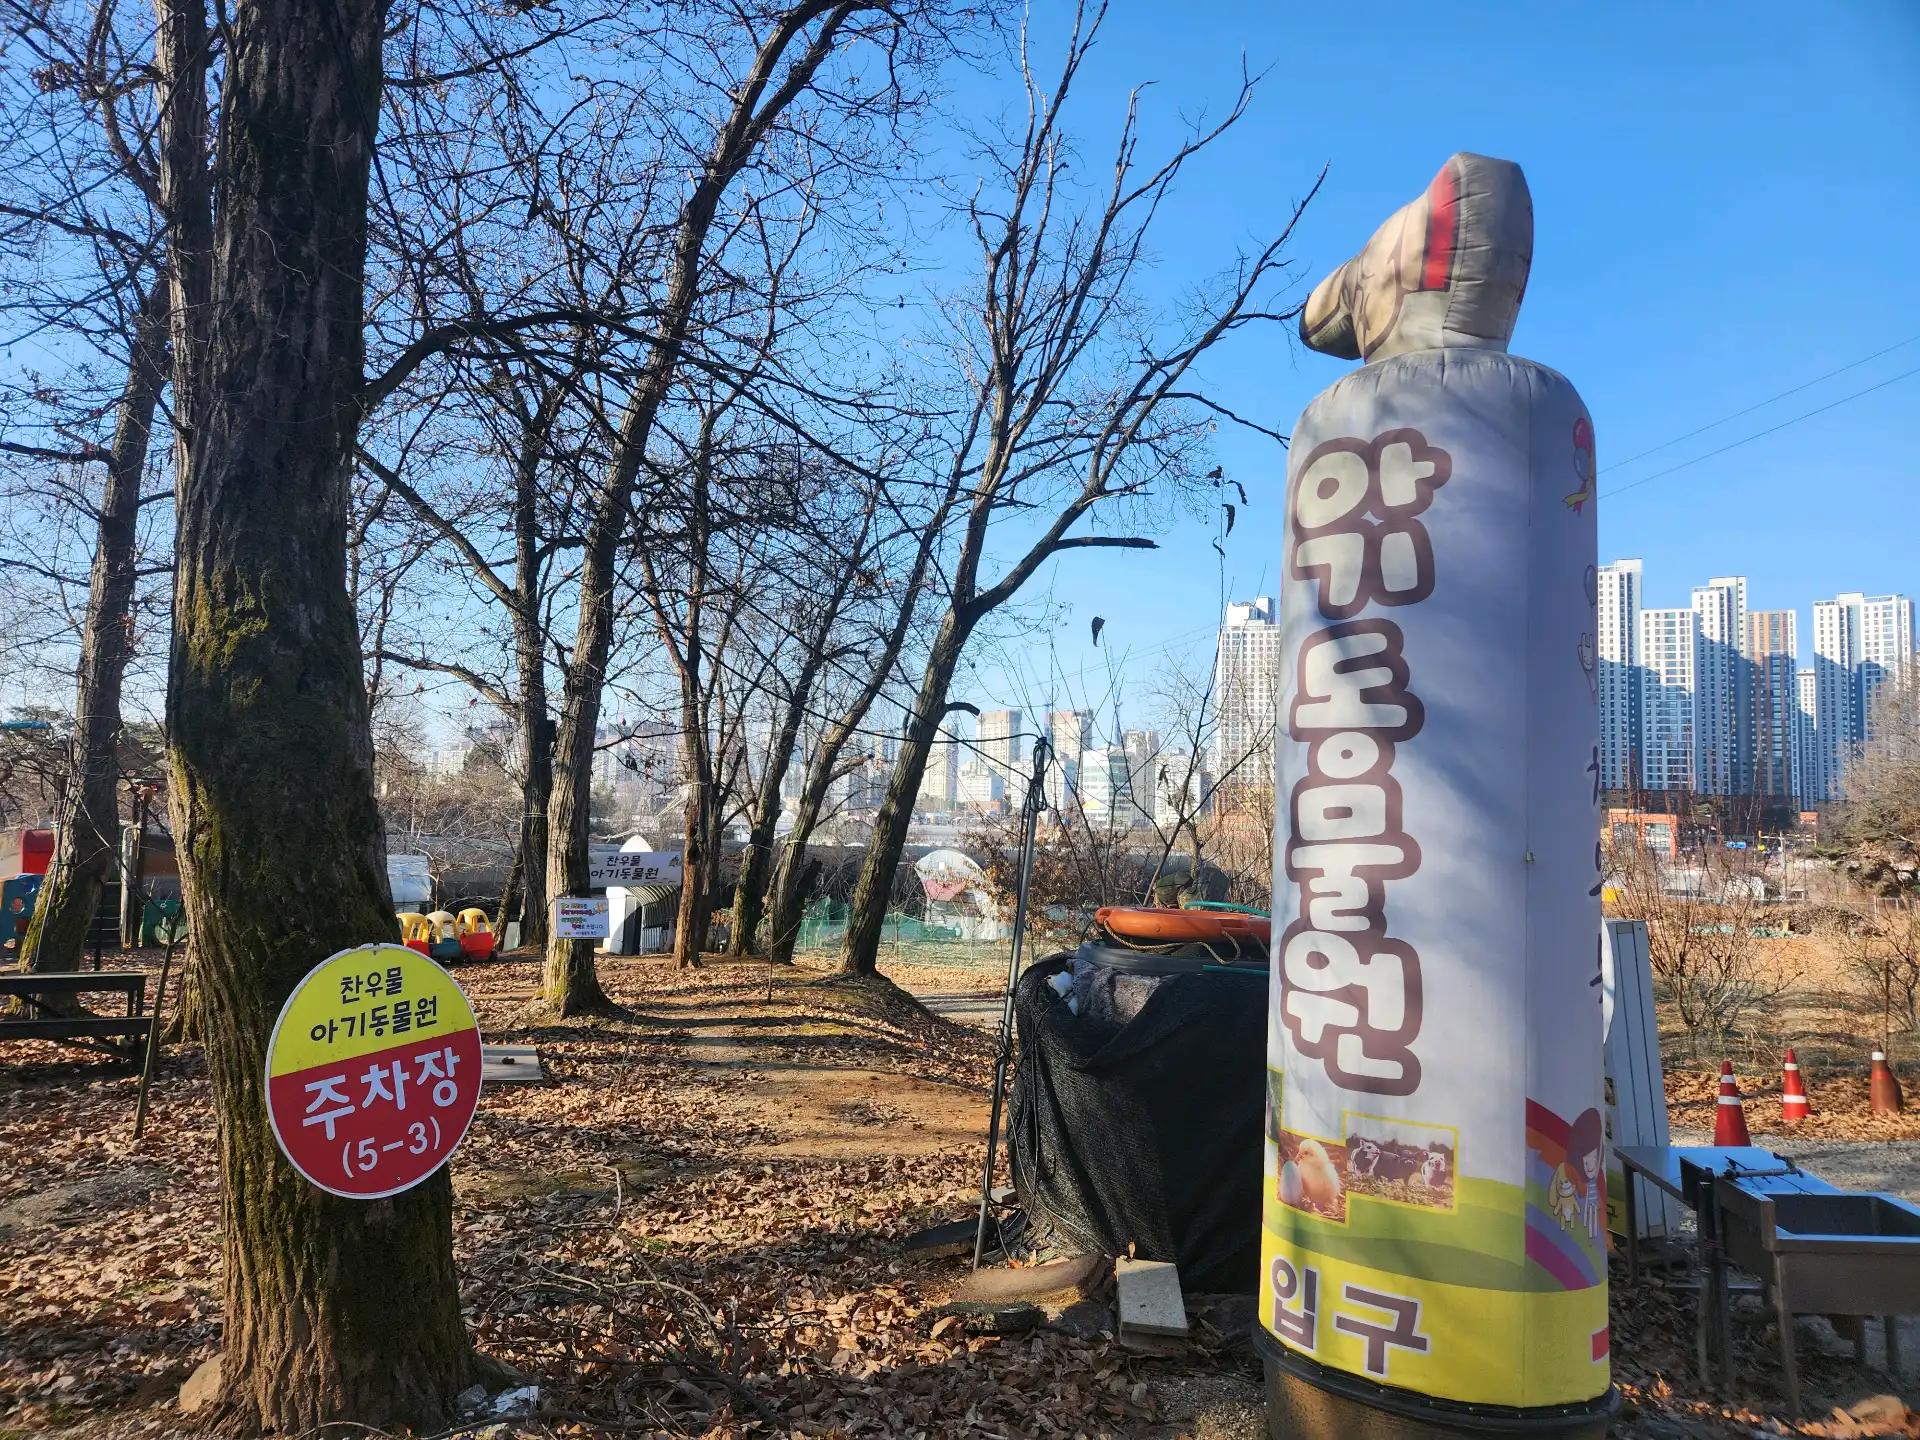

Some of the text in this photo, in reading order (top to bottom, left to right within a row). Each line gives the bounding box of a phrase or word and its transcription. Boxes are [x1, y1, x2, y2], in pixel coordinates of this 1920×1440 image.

[1279, 428, 1452, 1096] 아기동물원
[590, 867, 659, 880] 아기동물원
[606, 855, 641, 867] 찬우물
[341, 966, 402, 1004] 찬우물
[310, 996, 437, 1043] 아기동물원
[303, 1047, 460, 1140] 주차장
[342, 1116, 440, 1178] (5-3)
[1271, 1257, 1429, 1376] 입구
